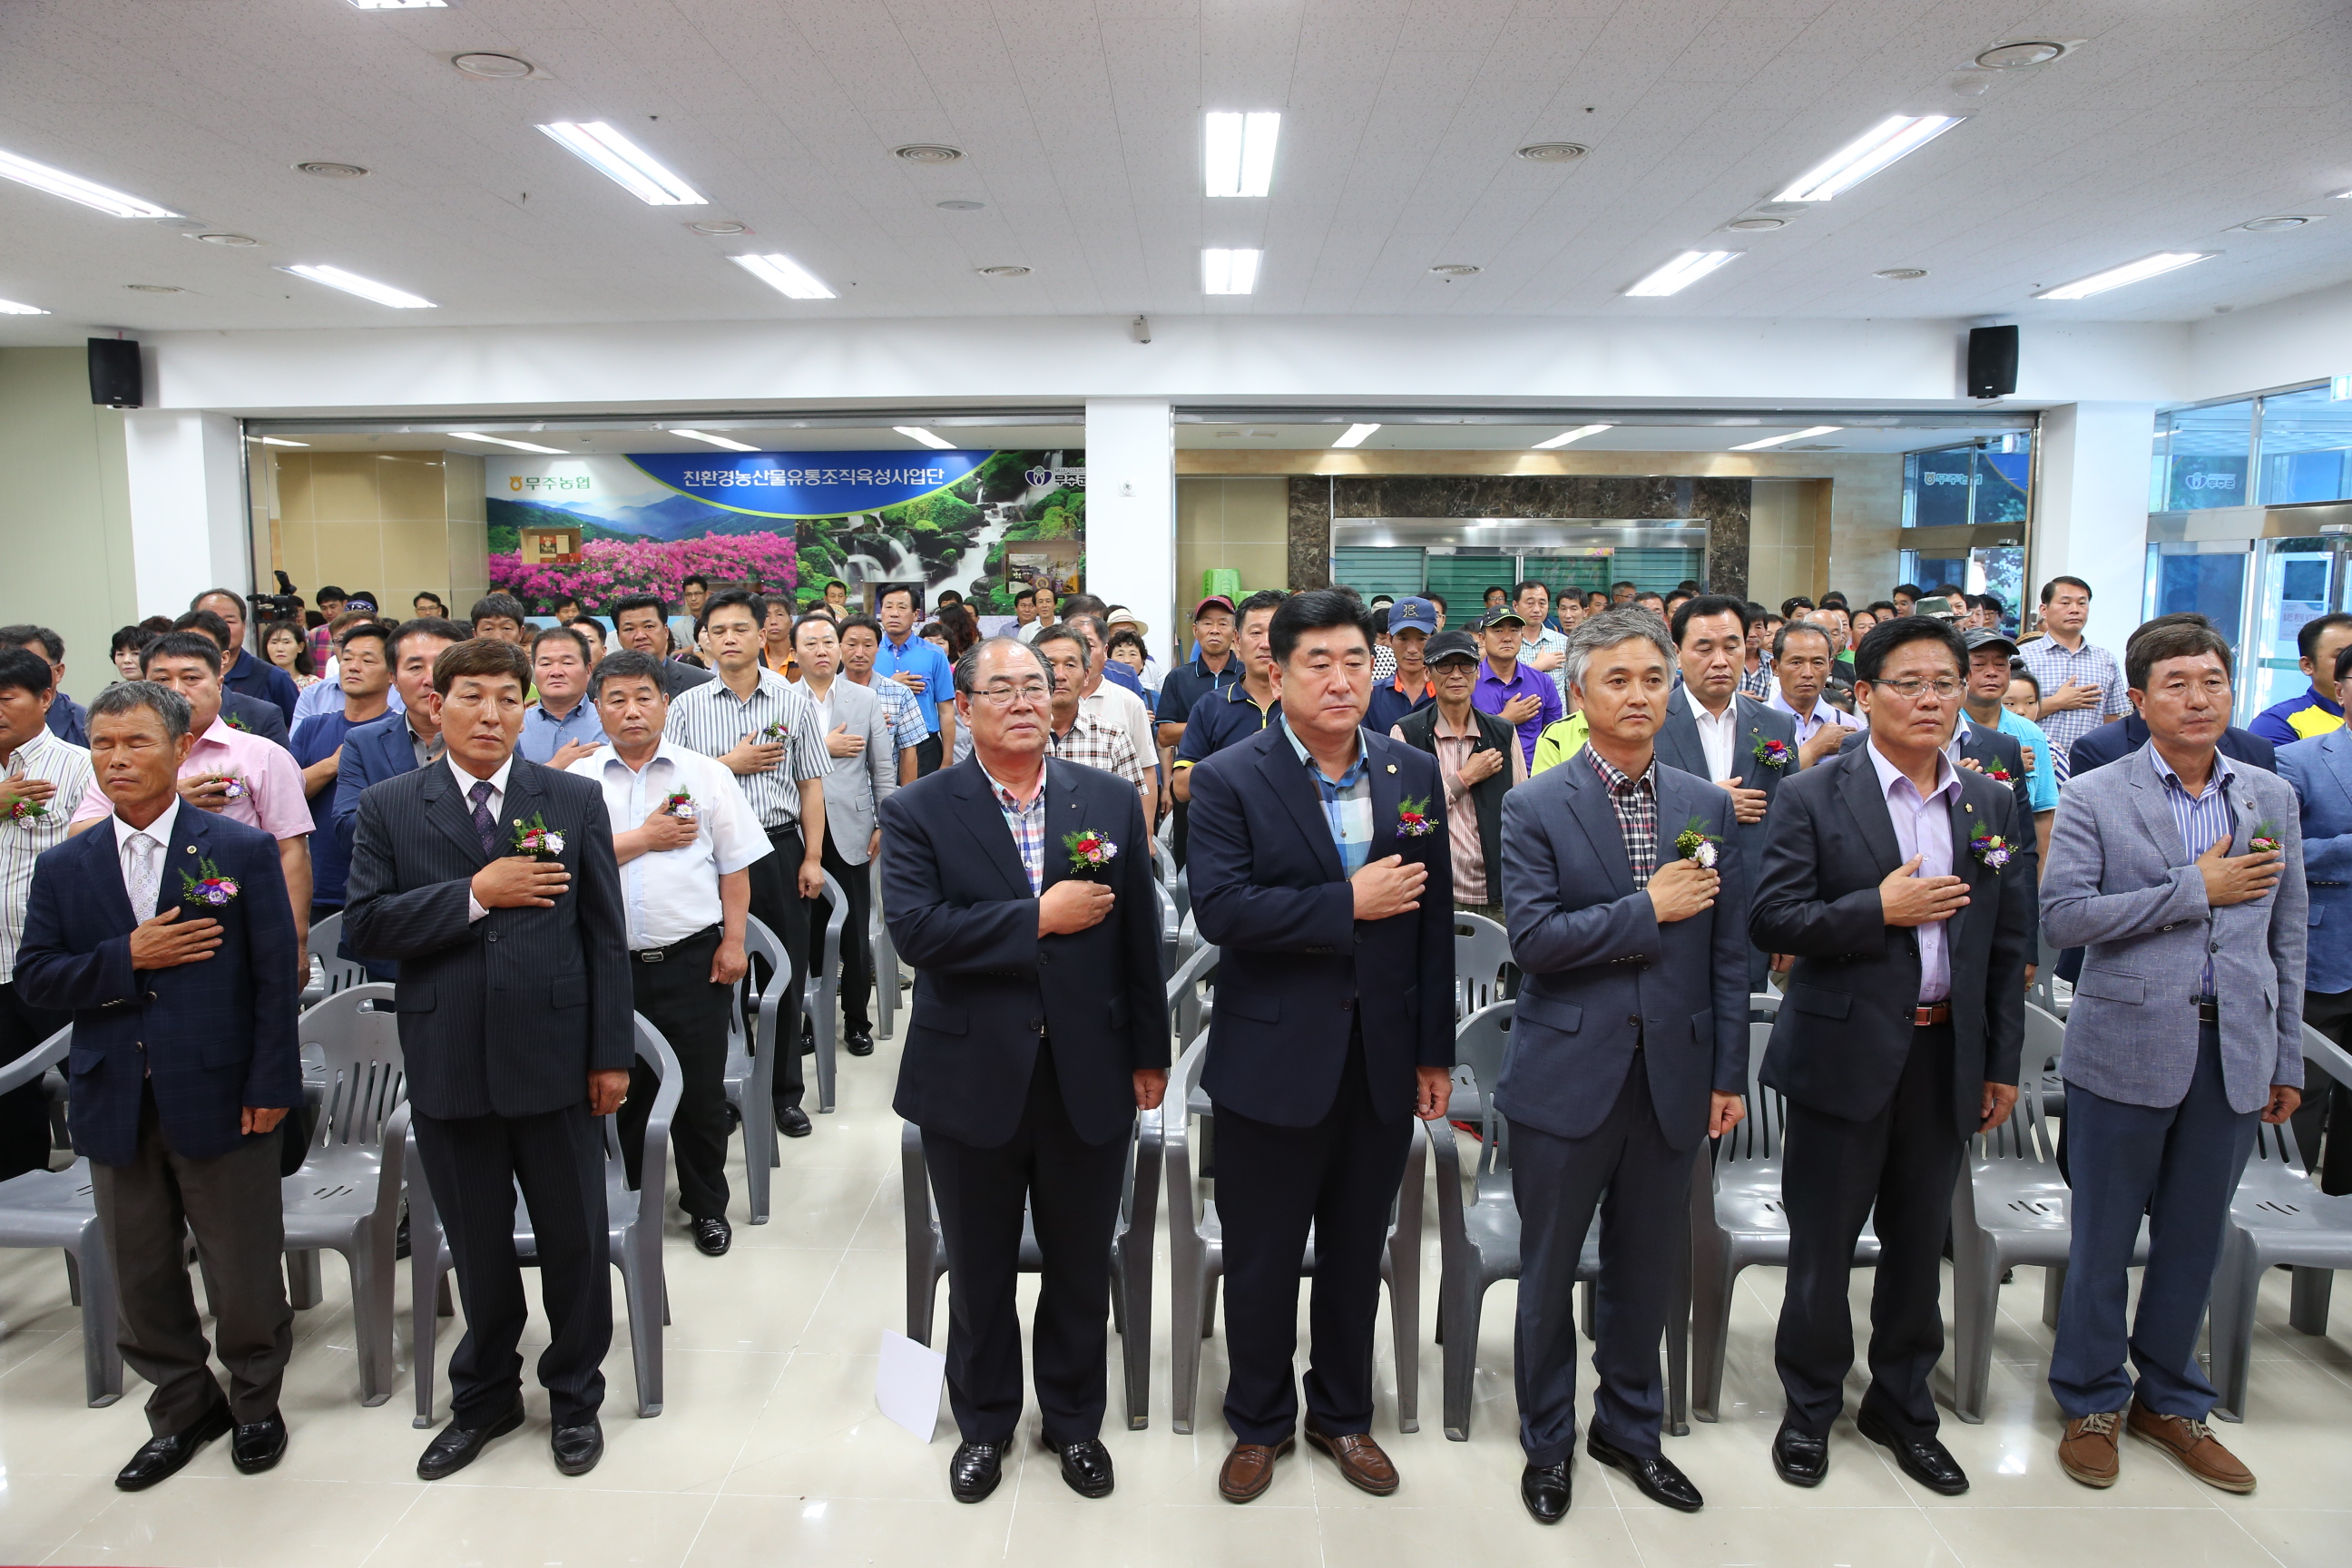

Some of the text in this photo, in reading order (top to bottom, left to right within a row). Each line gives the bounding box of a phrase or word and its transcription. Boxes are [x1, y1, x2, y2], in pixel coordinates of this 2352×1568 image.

[525, 476, 591, 491] 무주농협
[682, 468, 946, 487] 친환경농산물유통조직육성사업단
[2209, 479, 2234, 488] 무주군
